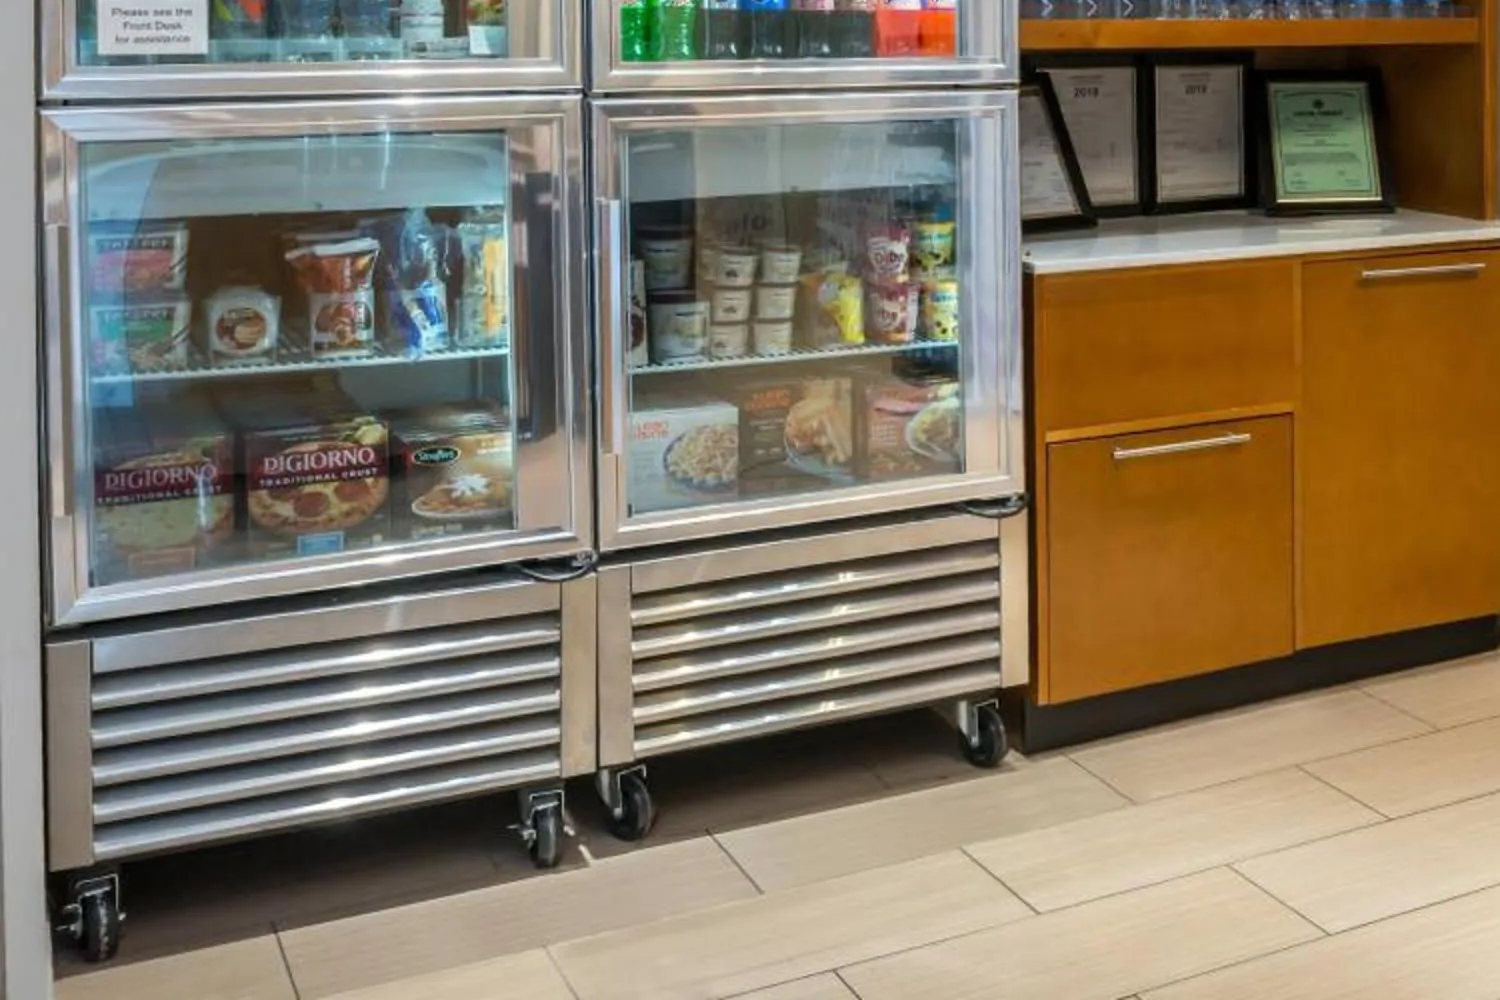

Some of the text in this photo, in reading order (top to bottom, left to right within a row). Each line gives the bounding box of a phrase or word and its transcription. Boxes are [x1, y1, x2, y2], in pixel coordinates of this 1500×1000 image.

[111, 8, 193, 17] Please see the
[123, 21, 182, 31] Front Desk
[115, 35, 191, 43] for assistance
[263, 447, 375, 475] DIGIORNO
[105, 465, 219, 490] DIGIORNO
[260, 467, 378, 487] TRADITIONAL CRUST
[97, 490, 179, 504] TRADITIONAL
